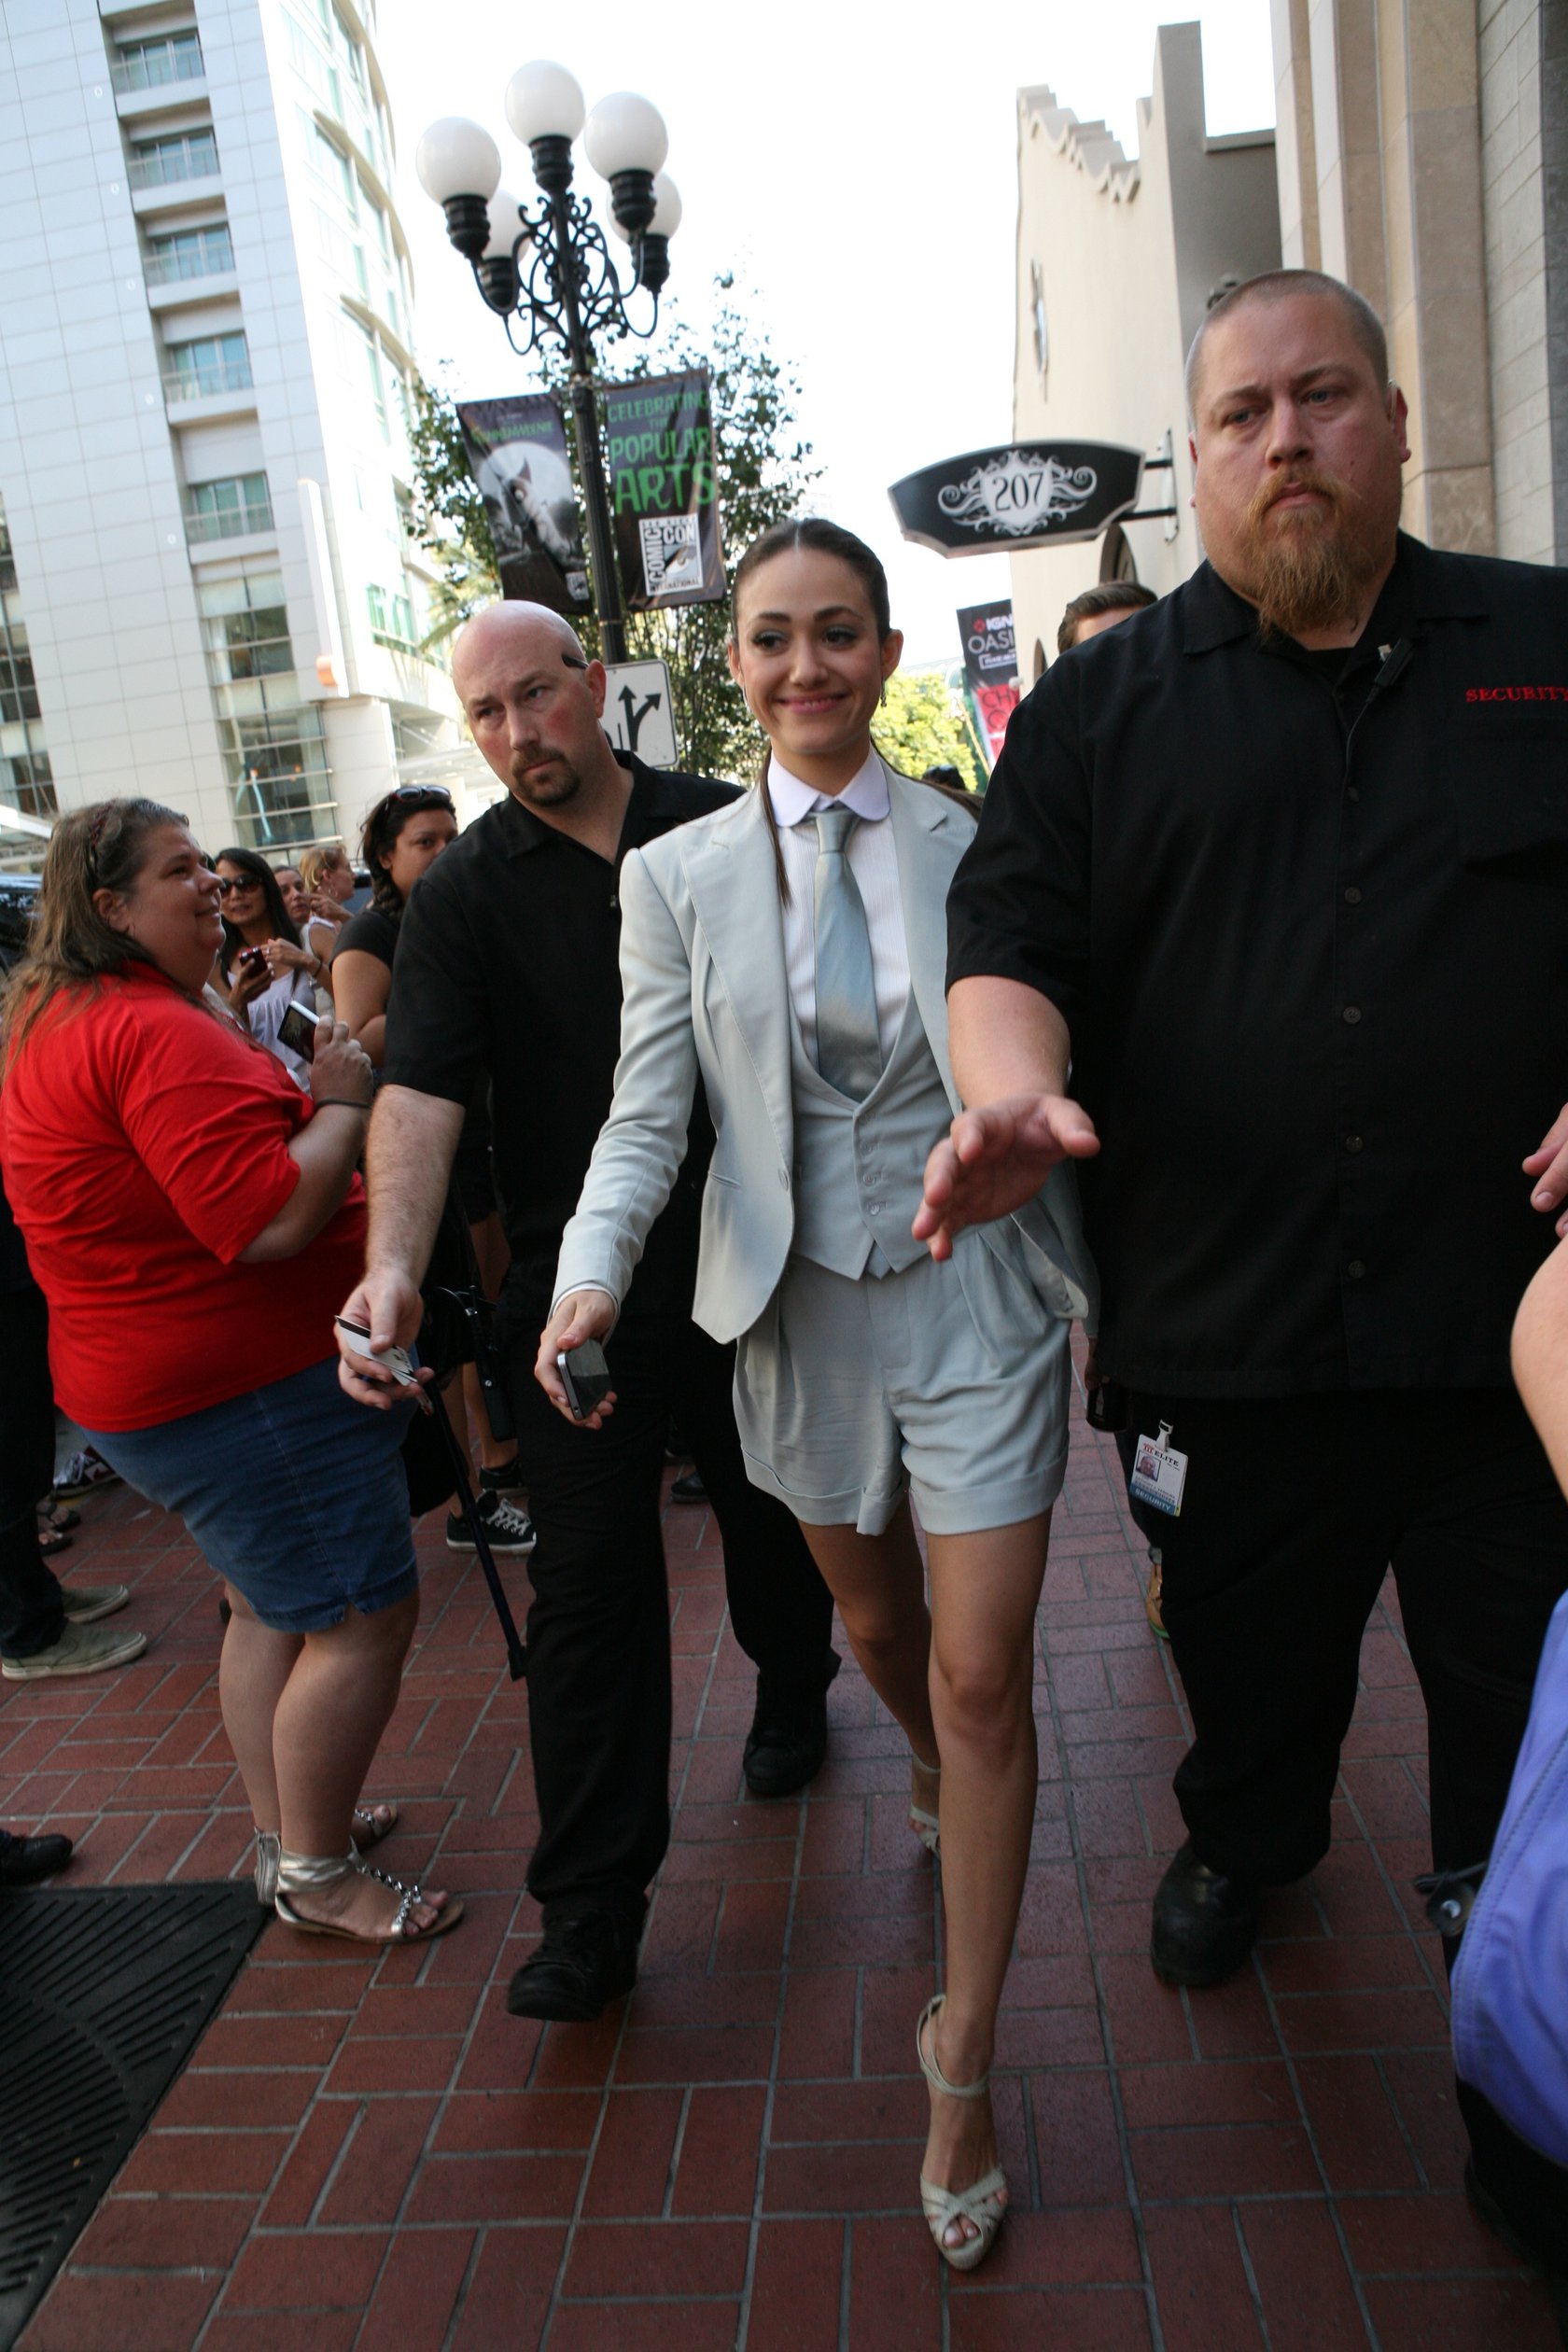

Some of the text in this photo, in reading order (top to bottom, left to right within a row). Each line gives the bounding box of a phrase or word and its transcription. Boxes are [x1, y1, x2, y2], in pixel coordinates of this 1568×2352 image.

[608, 390, 708, 424] CELEBRATING
[610, 427, 711, 465] POPULAR
[614, 462, 715, 514] ARTS
[991, 472, 1044, 511] 207
[663, 524, 695, 546] CON
[644, 527, 666, 583] COMIC
[986, 613, 1013, 631] IGN
[1155, 1450, 1180, 1467] ELITE
[1135, 1489, 1171, 1511] SECURITY
